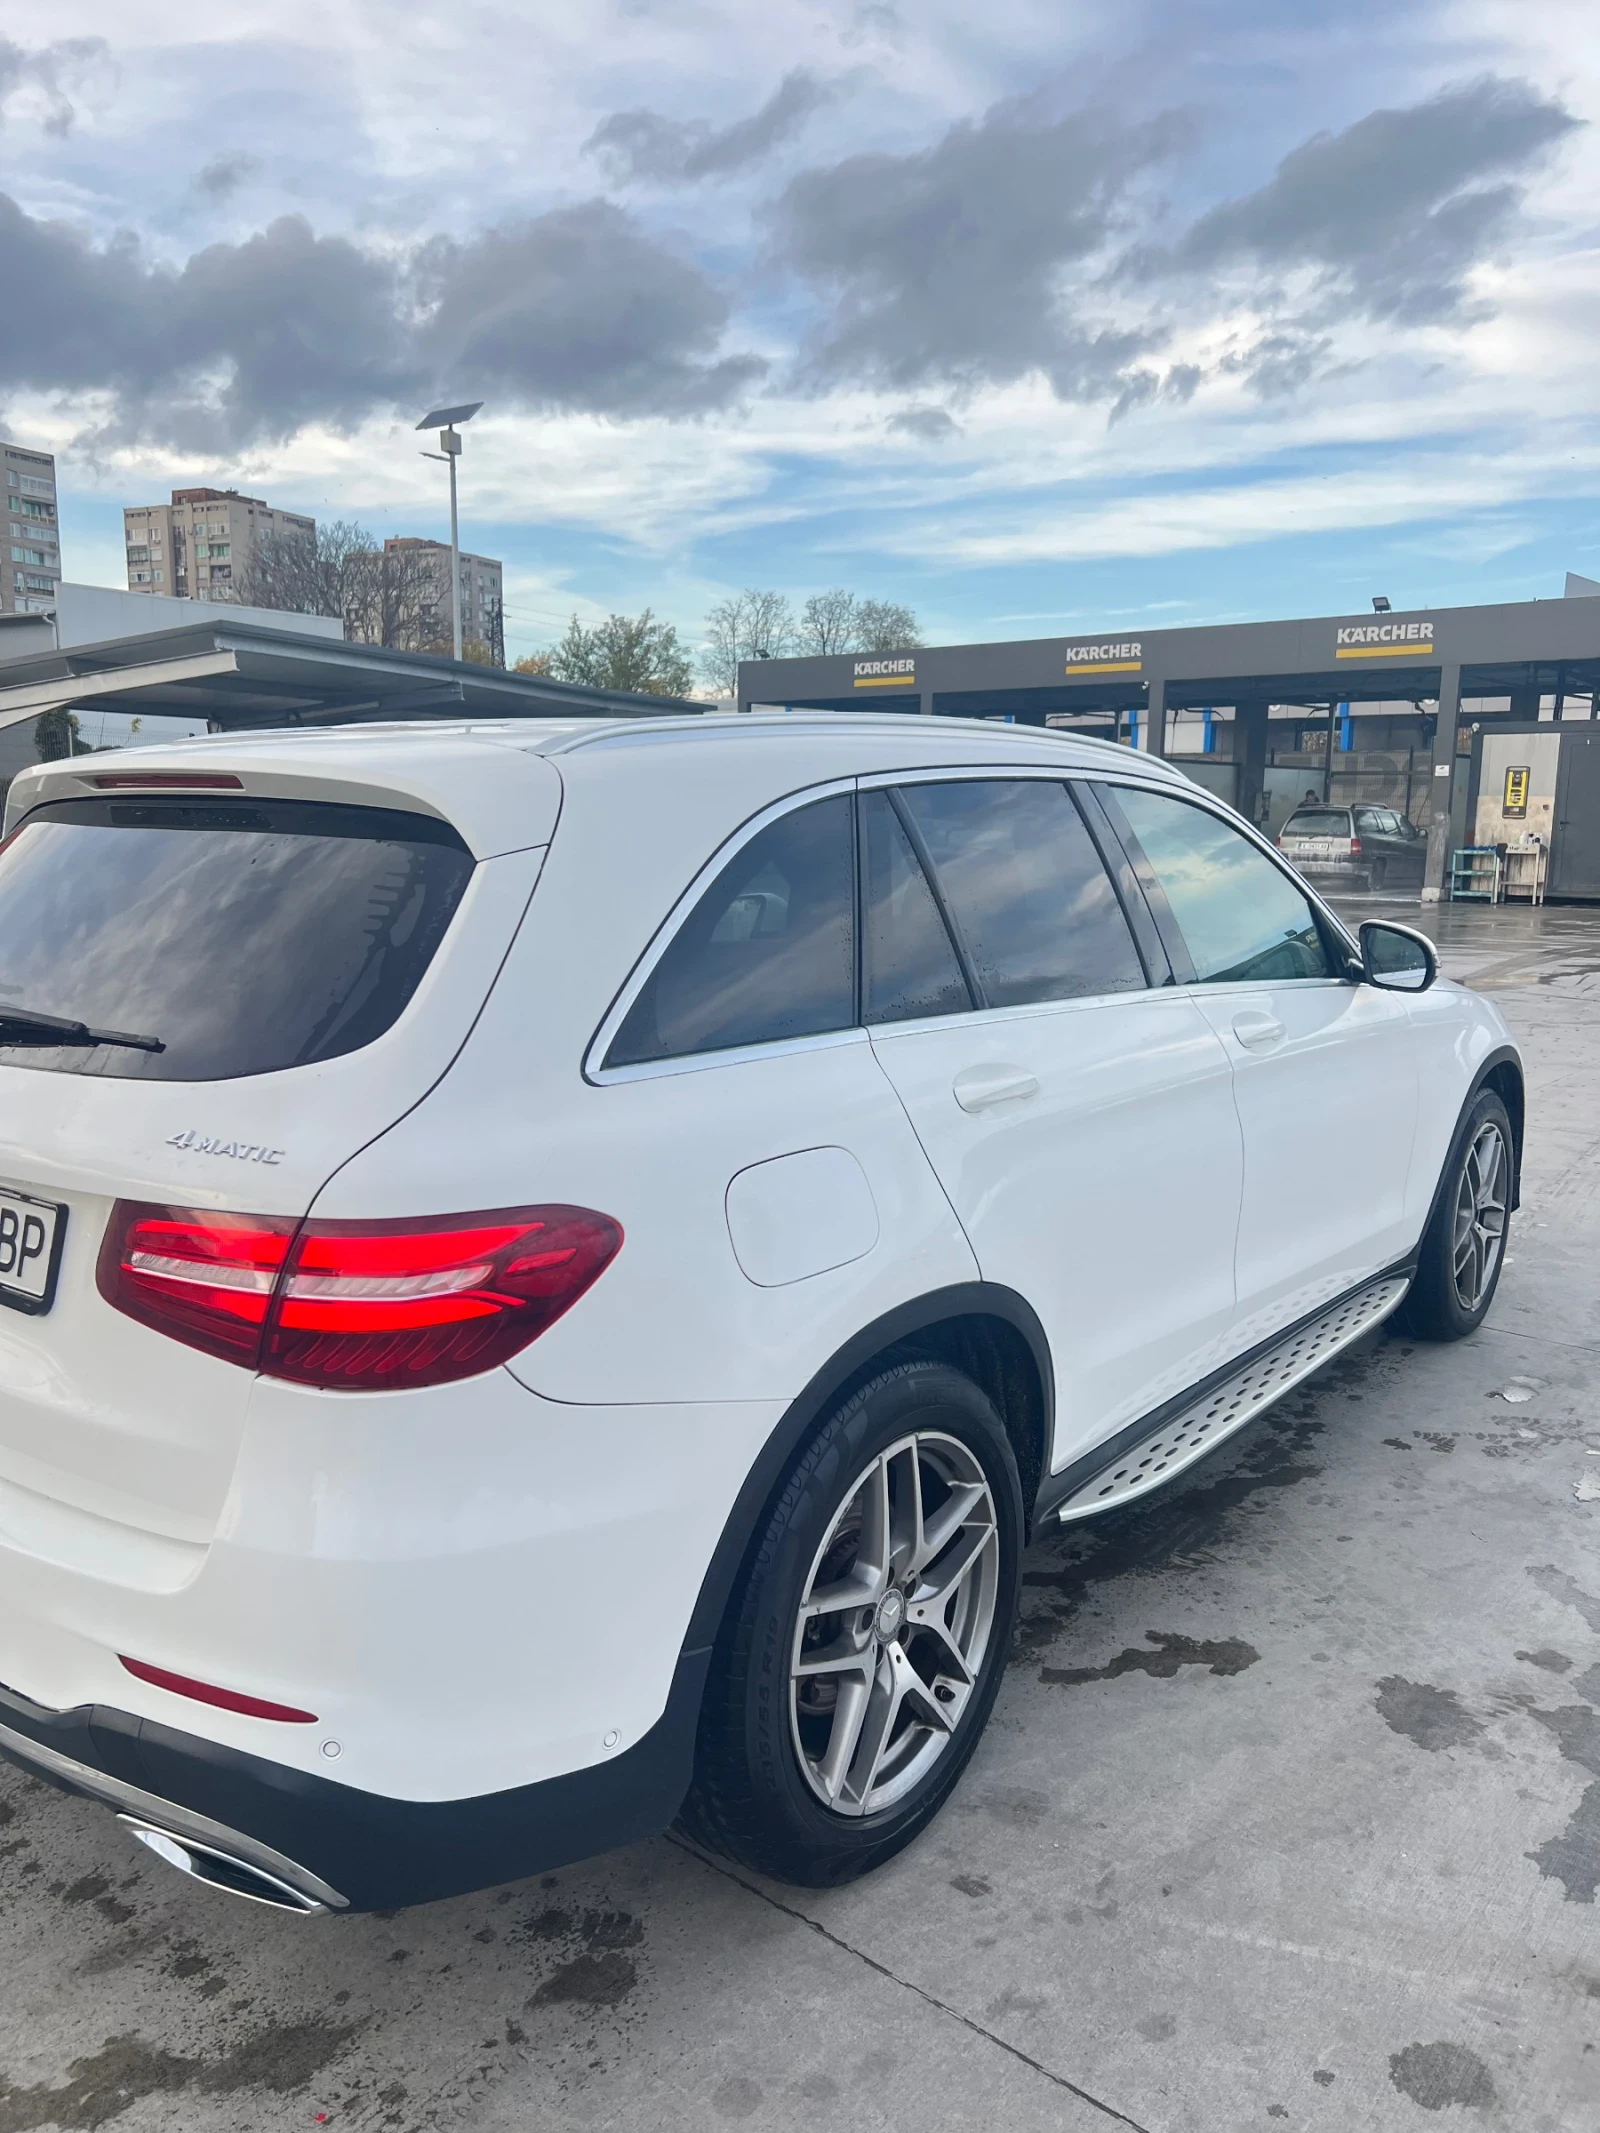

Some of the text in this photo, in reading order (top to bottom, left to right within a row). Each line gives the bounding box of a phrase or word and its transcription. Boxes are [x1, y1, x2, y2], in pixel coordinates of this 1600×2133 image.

[1337, 622, 1434, 644] KÄRCHER
[1066, 642, 1142, 662] KÄRCHER
[854, 659, 915, 676] KÄRCHER
[0, 1208, 45, 1277] BP
